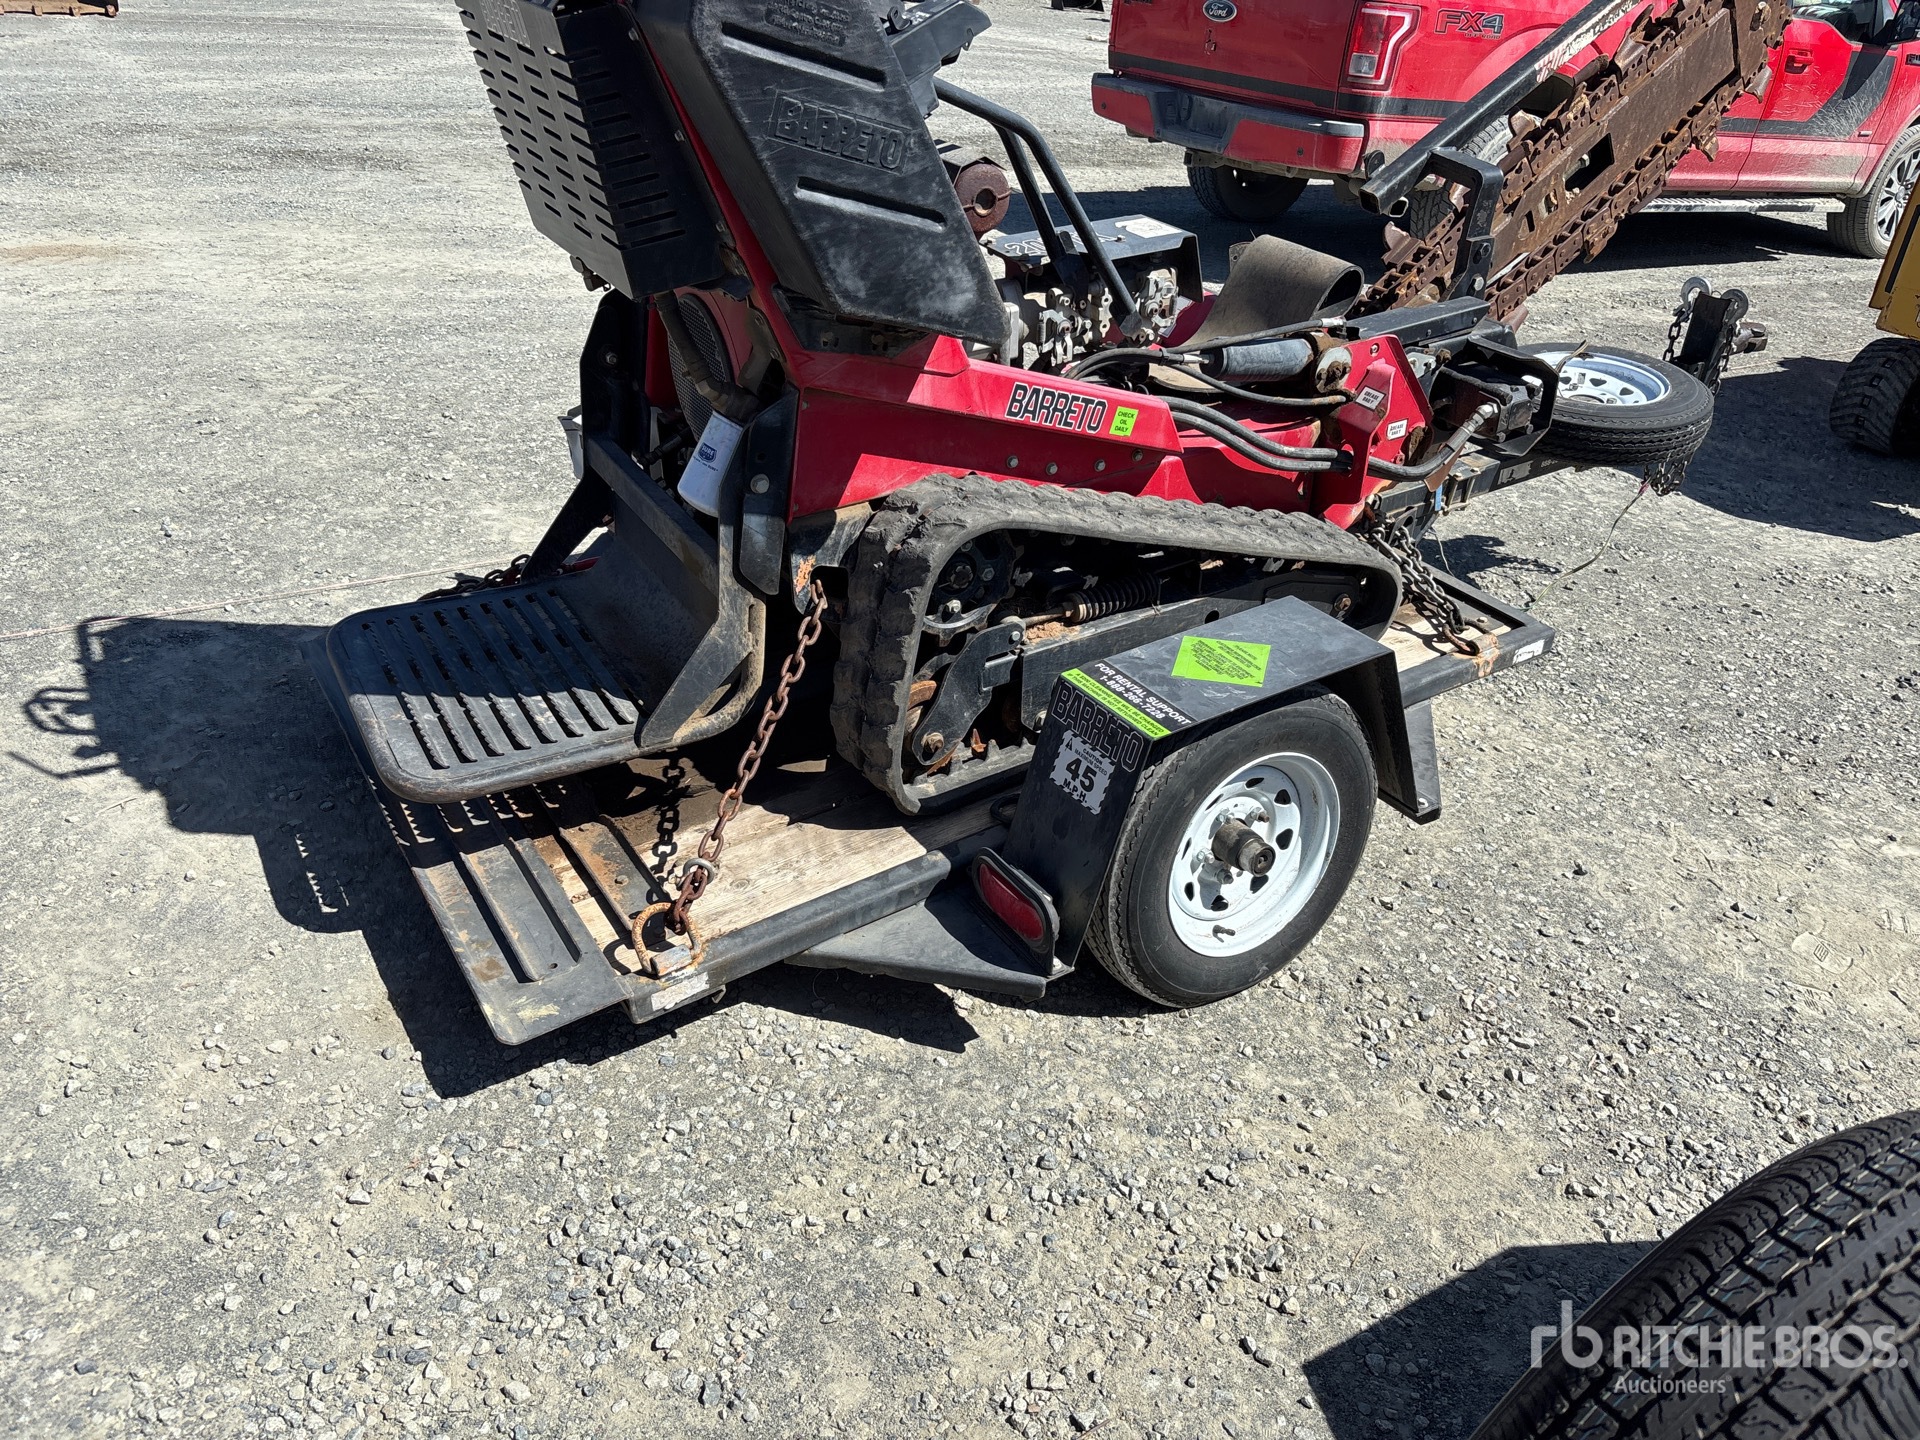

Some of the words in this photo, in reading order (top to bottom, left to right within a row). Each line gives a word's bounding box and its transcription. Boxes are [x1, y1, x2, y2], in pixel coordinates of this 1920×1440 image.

[1208, 3, 1228, 17] Ford
[1434, 8, 1505, 35] FX4
[774, 96, 905, 170] BARRETO
[1004, 381, 1109, 434] BARRETO
[1364, 391, 1379, 400] GREASE
[1117, 410, 1135, 419] CHECK
[1094, 662, 1112, 676] FOR
[1112, 674, 1147, 698] RENTAL
[1146, 696, 1192, 725] SUPPORT
[1100, 675, 1166, 719] 1-888-266-7228
[1051, 682, 1144, 773] BARRETO
[1074, 748, 1094, 766] MAXIMUM
[1093, 762, 1108, 776] SPEED
[1082, 748, 1103, 765] CAUTION
[1065, 757, 1098, 792] 45
[1063, 778, 1088, 803] M.P.H.
